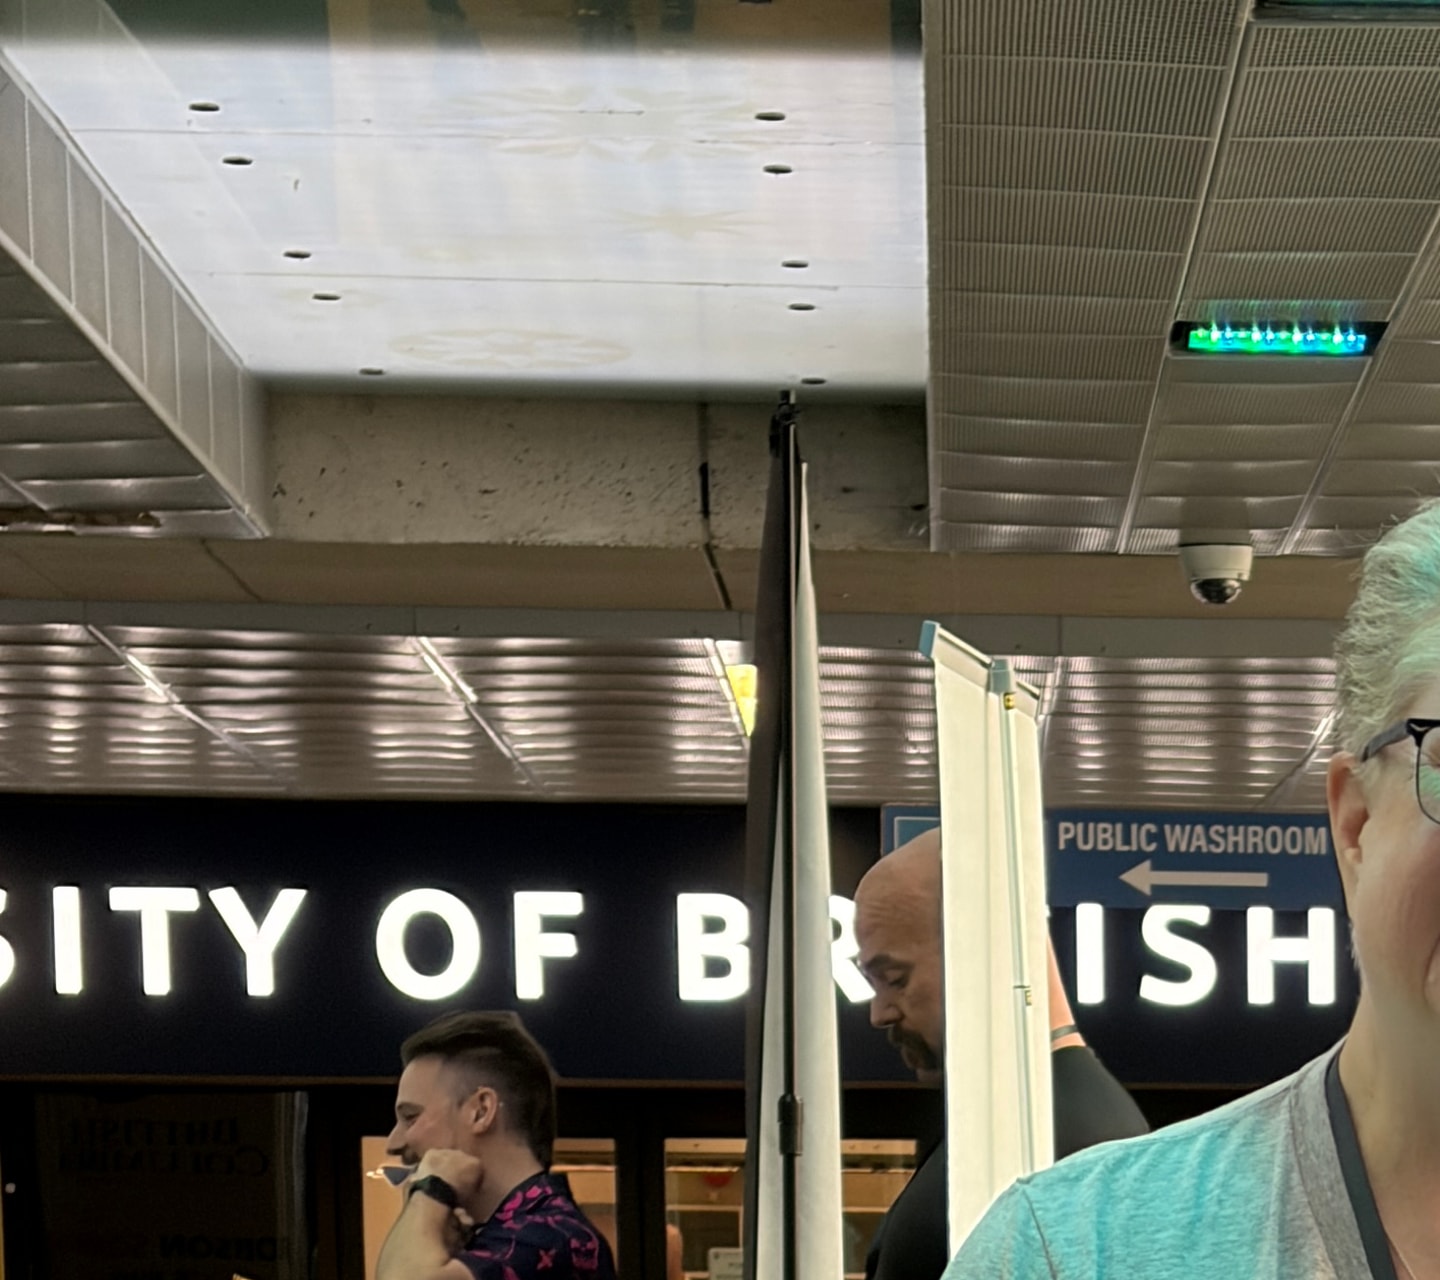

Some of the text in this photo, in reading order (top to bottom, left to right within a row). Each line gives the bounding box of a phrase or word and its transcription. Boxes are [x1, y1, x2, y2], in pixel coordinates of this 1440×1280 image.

[1057, 822, 1327, 856] PUBLIC WASHROOM
[375, 887, 584, 1000] OF
[676, 891, 1336, 1004] BRISH
